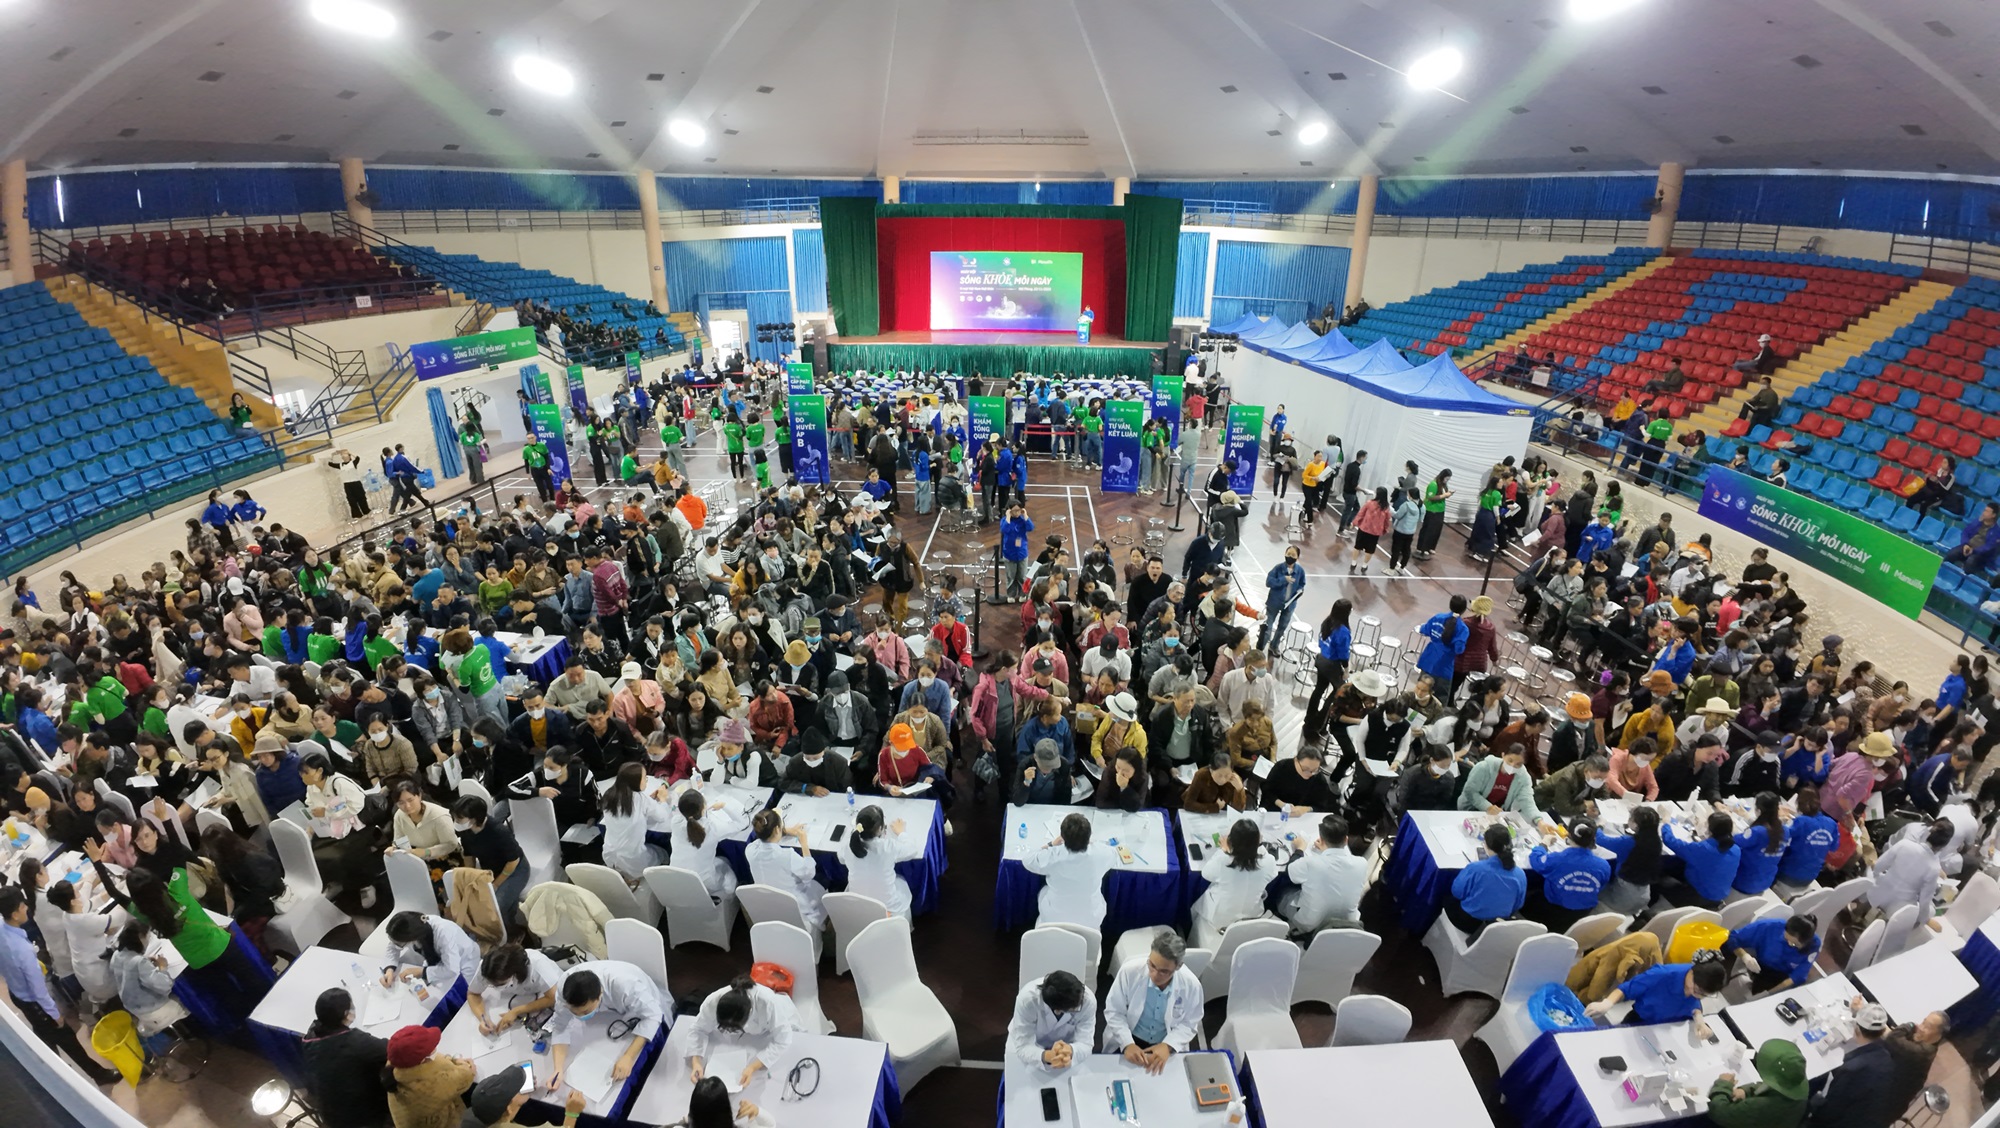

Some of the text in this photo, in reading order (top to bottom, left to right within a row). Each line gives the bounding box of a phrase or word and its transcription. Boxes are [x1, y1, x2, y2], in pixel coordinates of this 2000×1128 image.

[960, 275, 981, 284] SỐNG
[1014, 274, 1029, 285] MỖI
[1030, 276, 1053, 285] NGÀY
[453, 349, 468, 360] SỐNG
[973, 417, 992, 425] KHÁM
[796, 422, 816, 430] HUYẾT
[538, 431, 555, 439] HUYẾT
[973, 432, 990, 440] QUÁT
[1121, 430, 1138, 439] LUẬN
[1231, 434, 1256, 442] NGHIỆM
[797, 439, 805, 448] B
[1229, 449, 1236, 458] A
[1750, 503, 1779, 523] SỐNG
[1778, 512, 1820, 540] KHỎE
[1817, 532, 1841, 550] MỖI
[1839, 542, 1872, 564] NGÀY
[1894, 569, 1925, 591] Manulife
